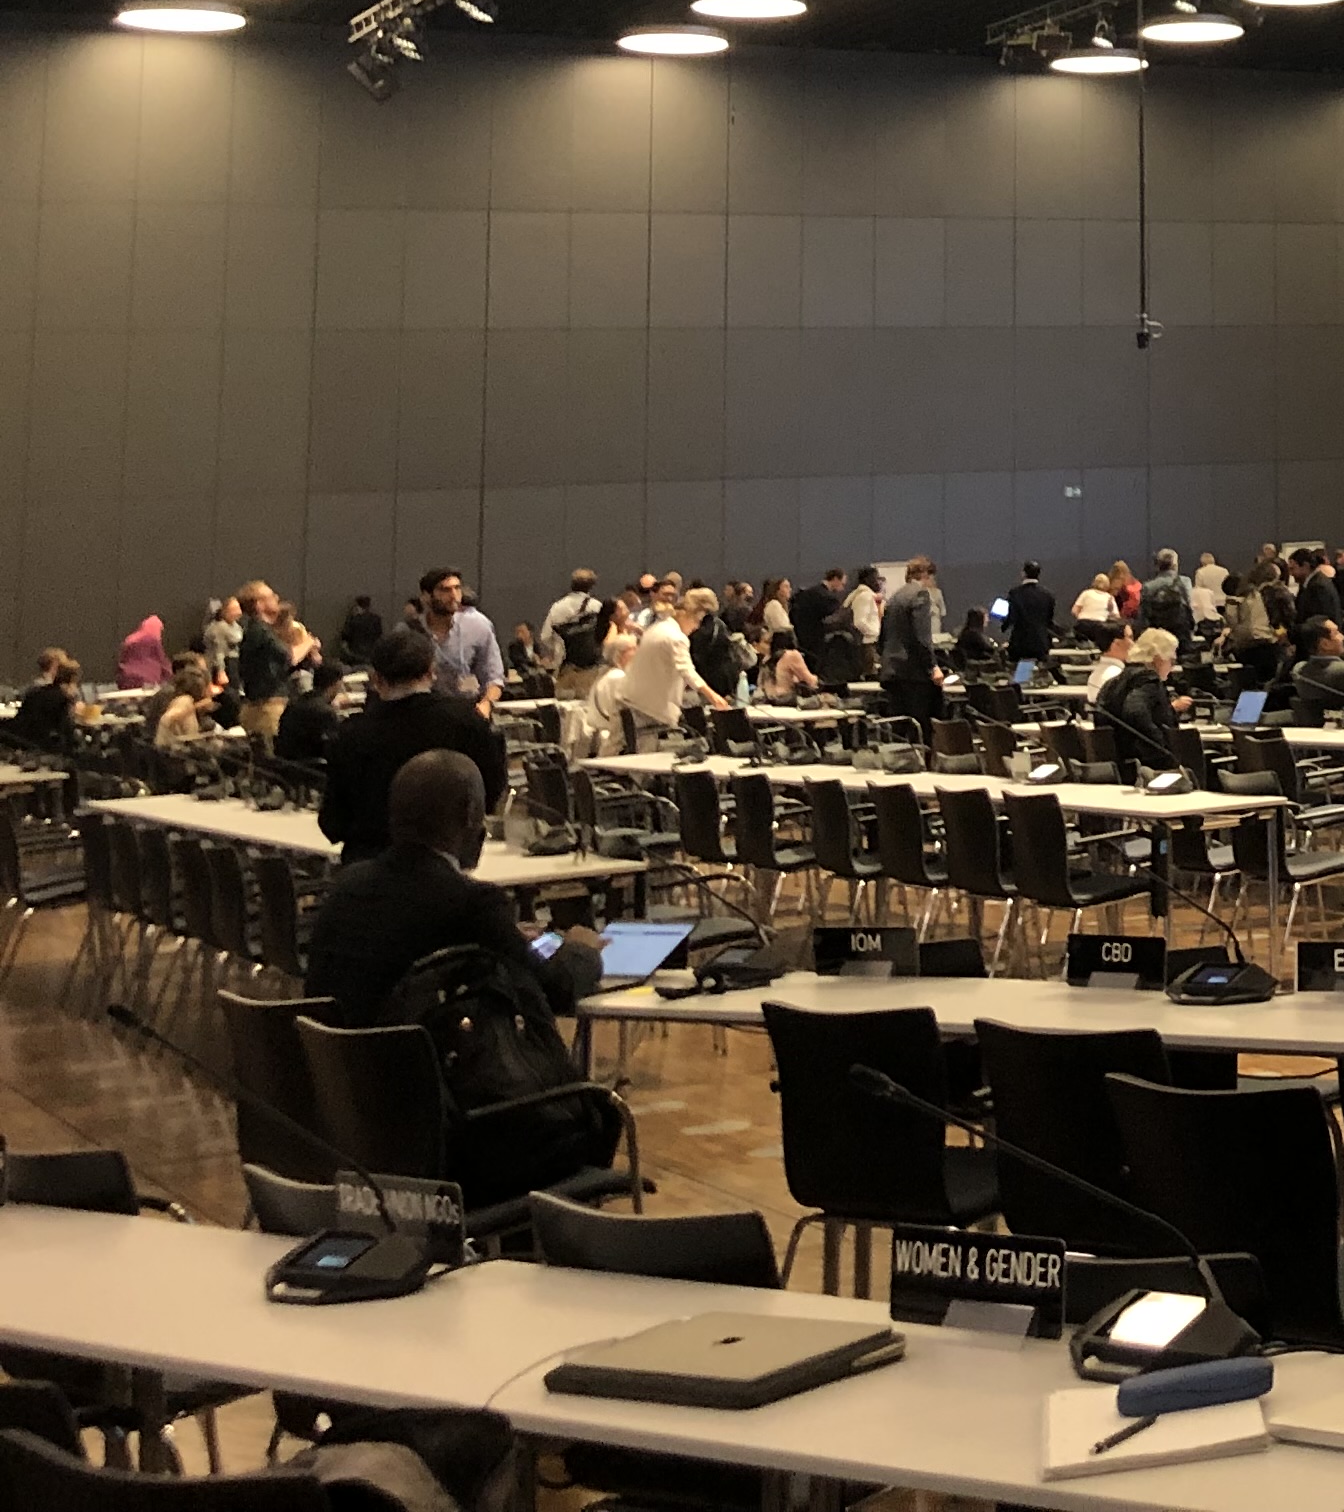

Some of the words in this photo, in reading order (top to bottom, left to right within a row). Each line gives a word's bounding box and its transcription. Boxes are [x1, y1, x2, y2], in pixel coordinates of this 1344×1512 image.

[851, 932, 882, 952] IOM
[1101, 942, 1132, 963] CBD
[424, 1192, 460, 1225] NGOs
[896, 1239, 962, 1279] WOMEN
[966, 1246, 980, 1280] &
[985, 1248, 1062, 1287] GENDER
